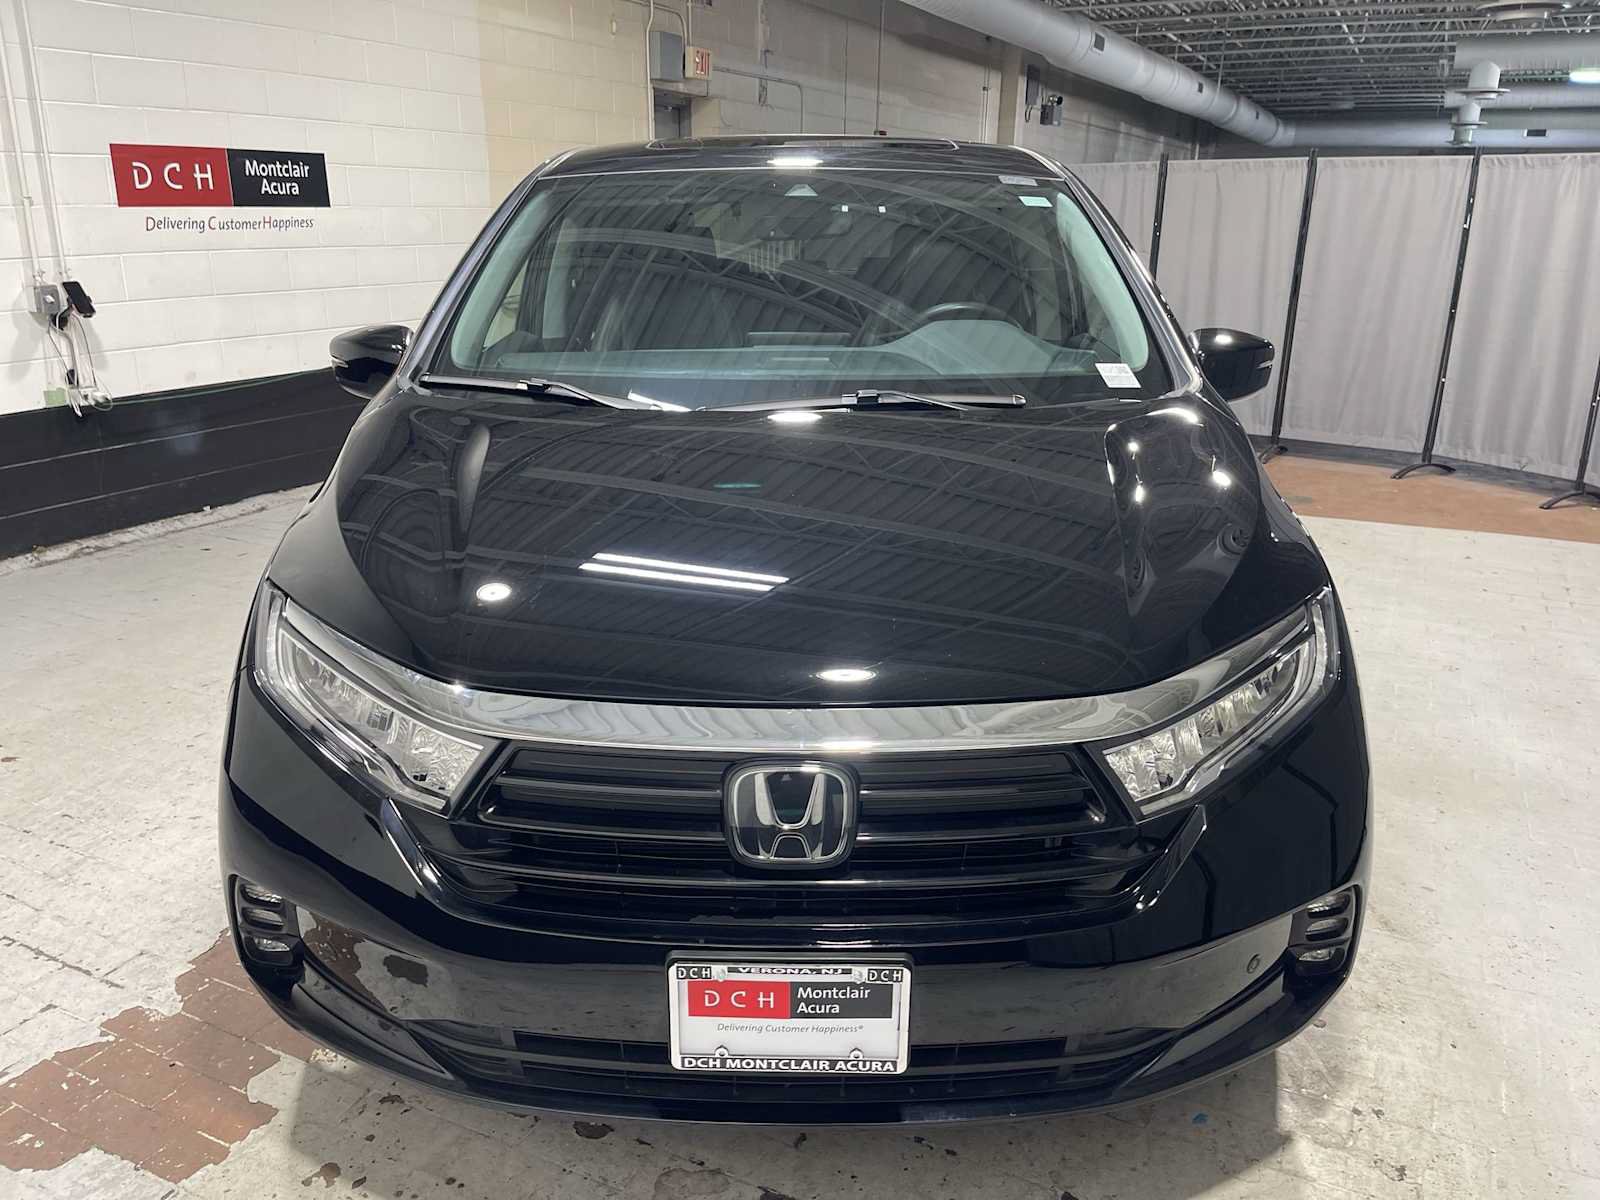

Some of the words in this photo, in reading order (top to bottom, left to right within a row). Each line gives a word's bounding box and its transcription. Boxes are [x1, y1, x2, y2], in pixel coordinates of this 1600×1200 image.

[245, 159, 309, 178] Montclair
[261, 179, 300, 195] Acura
[146, 216, 205, 233] Delivering
[678, 967, 712, 978] DCH
[868, 970, 902, 981] DCH
[797, 987, 870, 999] Montclair
[797, 1002, 840, 1013] Acura
[717, 1023, 763, 1033] Delivering
[766, 1024, 809, 1033] Customer
[684, 1059, 721, 1068] DCH
[726, 1059, 830, 1070] MONTCLAIR
[835, 1060, 894, 1071] ACURA
